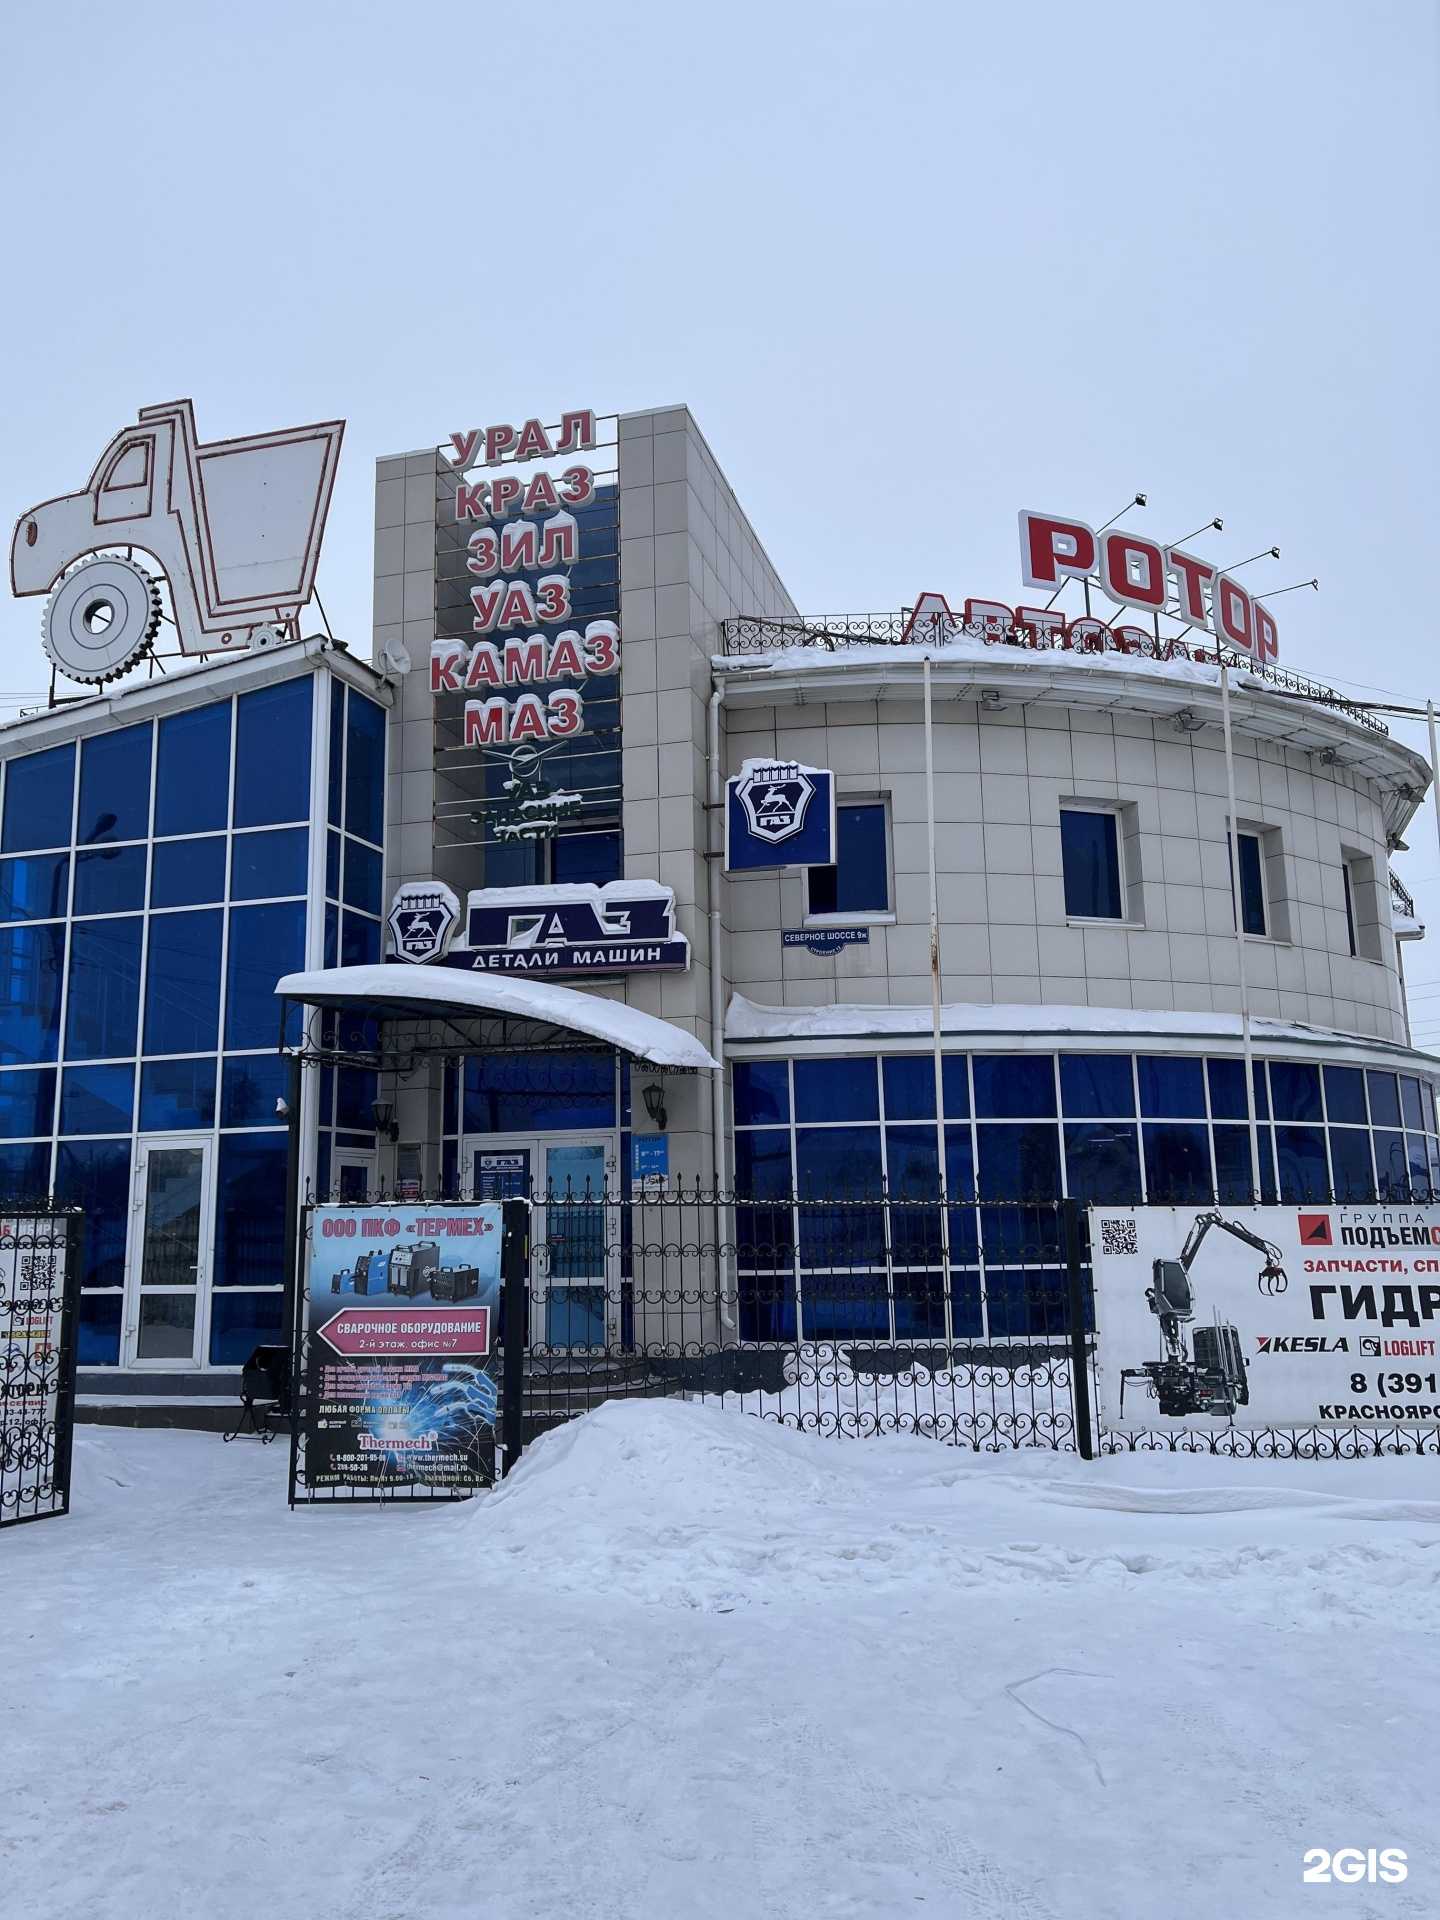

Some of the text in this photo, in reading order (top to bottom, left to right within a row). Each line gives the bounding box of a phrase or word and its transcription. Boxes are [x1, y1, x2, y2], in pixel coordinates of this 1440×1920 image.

[449, 409, 595, 470] УРАЛ
[455, 466, 593, 521] КРАЗ
[467, 518, 577, 575] ЗИЛ
[1018, 509, 1280, 664] РОТОР
[470, 577, 571, 632] УАЗ
[430, 628, 620, 693] КАМАЗ
[464, 696, 584, 746] МАЗ
[759, 815, 790, 827] ГАЗ
[463, 898, 674, 950] ГАЗ
[406, 940, 433, 951] ГАЗ
[784, 932, 826, 942] СЕВЕРНОЕ
[827, 931, 856, 940] ШОССЕ
[472, 947, 661, 969] ДЕТАЛИ МАШИН
[322, 1217, 494, 1238] ООО ПКФ «ТЕРМЕХ»
[1340, 1213, 1425, 1223] ГРУППА
[1303, 1259, 1409, 1275] ЗАПЧАСТИ,
[1309, 1285, 1440, 1328] ГИДР
[337, 1322, 481, 1335] СВАРОЧНОЕ ОБОРУДОВАНИЕ
[359, 1339, 376, 1349] 2-й
[411, 1339, 439, 1350] офис
[1273, 1336, 1436, 1356] KESLA LOGLIFT
[1350, 1373, 1437, 1398] 8 (391
[319, 1405, 348, 1414] ЛЮБАЯ
[349, 1405, 376, 1414] ФОРМА
